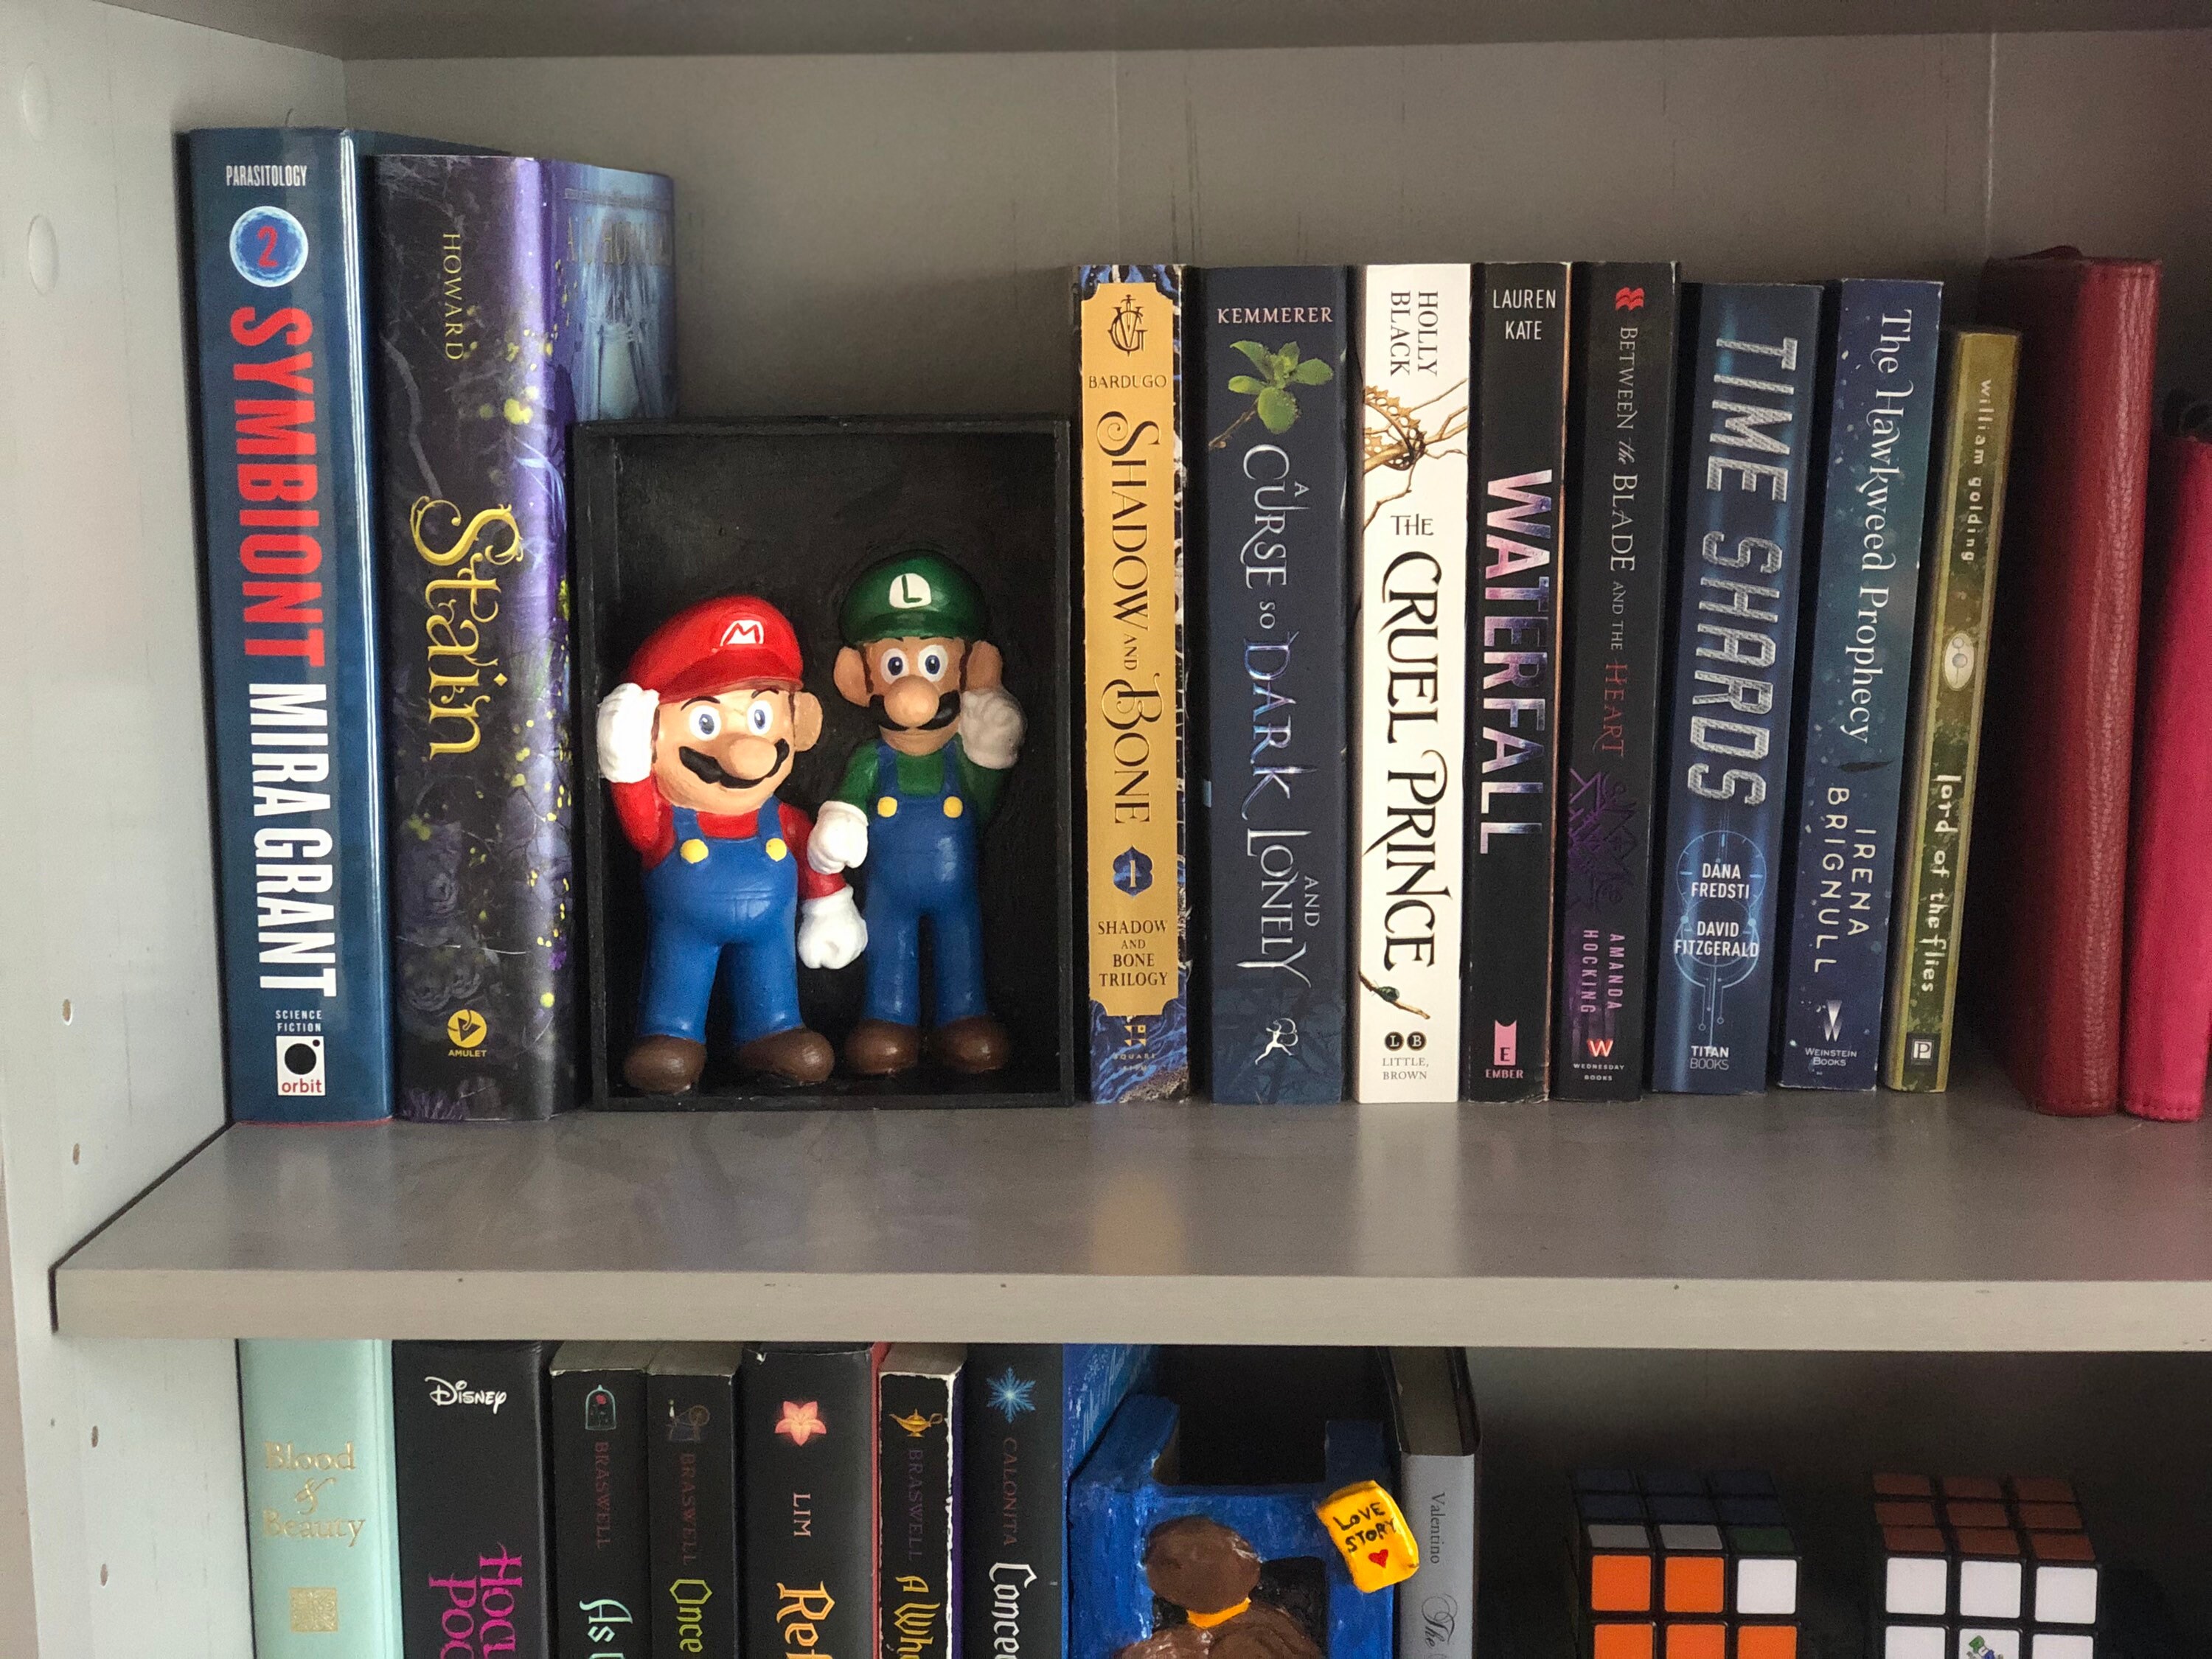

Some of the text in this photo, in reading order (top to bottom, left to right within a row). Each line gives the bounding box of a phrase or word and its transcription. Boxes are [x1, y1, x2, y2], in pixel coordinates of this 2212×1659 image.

[226, 165, 307, 187] PARASITOLOGY
[257, 226, 278, 268] 2
[443, 233, 464, 361] HOWARD
[1217, 307, 1333, 324] KEMMERER
[1493, 290, 1557, 309] LAUREN
[1390, 291, 1410, 376] BLACK
[1418, 291, 1439, 376] HOLLY
[1505, 321, 1542, 340] KATE
[1088, 375, 1166, 389] BARDUGO
[230, 307, 325, 667] SYMBIONT
[1961, 380, 1994, 562] william golding
[1240, 444, 1310, 589] CURSE
[1391, 515, 1434, 536] THE
[1840, 309, 1914, 743] The Hawkweed Prophecy
[1593, 327, 1638, 759] BETWEEN the BLADE AND THE HEART
[902, 575, 922, 602] L
[1688, 338, 1798, 805] TIME SHARDS
[410, 495, 523, 761] Stain
[721, 622, 764, 644] M
[1096, 411, 1164, 824] SHADOW AND BONE
[1259, 601, 1276, 629] SO
[1480, 469, 1552, 855] WATERFALL
[1241, 631, 1318, 820] DARK
[1363, 551, 1453, 971] CRUEL PRINCE
[248, 684, 336, 997] MIRA GRANT
[1703, 863, 1741, 880] DANA
[1815, 788, 1849, 973] BRIGNULL
[1848, 830, 1876, 936] IRENA
[1919, 774, 1961, 992] lord of the flies
[1237, 828, 1312, 988] LONELY
[1304, 875, 1320, 927] AND
[1691, 883, 1750, 899] FREDSTI
[1098, 920, 1167, 934] SHADOW
[1121, 939, 1146, 949] AND
[1697, 921, 1739, 936] DAVID
[1113, 954, 1155, 967] BONE
[1674, 939, 1759, 958] FITZGERALD
[1099, 972, 1168, 987] TRILOGY
[1581, 930, 1599, 1013] HOCKING
[1607, 934, 1625, 1009] AMANDA
[275, 1010, 322, 1020] SCIENCE
[277, 1023, 321, 1032] FICTION
[448, 1049, 487, 1057] AMULET
[1382, 1057, 1429, 1068] LITTLE,
[1500, 1048, 1510, 1062] E
[1587, 1039, 1613, 1057] W
[1690, 1057, 1729, 1071] BOOKS
[1691, 1046, 1729, 1057] TITAN
[1805, 1048, 1857, 1057] WEINSTEIN
[1814, 1057, 1846, 1066] BOOKS
[1916, 1043, 1930, 1059] P
[281, 1078, 322, 1093] orbit
[1382, 1071, 1427, 1080] BROWN
[1486, 1069, 1524, 1079] EMBER
[425, 1377, 507, 1413] Disney
[265, 1441, 355, 1470] Blood
[594, 1441, 611, 1548] BRASWELL
[679, 1453, 697, 1565] BRASWELL
[907, 1449, 923, 1561] BRASWELL
[1001, 1437, 1018, 1545] CALONITA
[262, 1509, 365, 1547] Beauty
[793, 1492, 811, 1537] LIM
[1333, 1502, 1386, 1531] LOVE
[1430, 1492, 1445, 1564] Valentino
[1345, 1519, 1397, 1553] STORY
[580, 1599, 633, 1643] As
[669, 1579, 712, 1653] Once
[776, 1581, 835, 1659] Re
[894, 1576, 940, 1659] A Wh
[989, 1562, 1037, 1659] Conce
[1422, 1593, 1458, 1649] The
